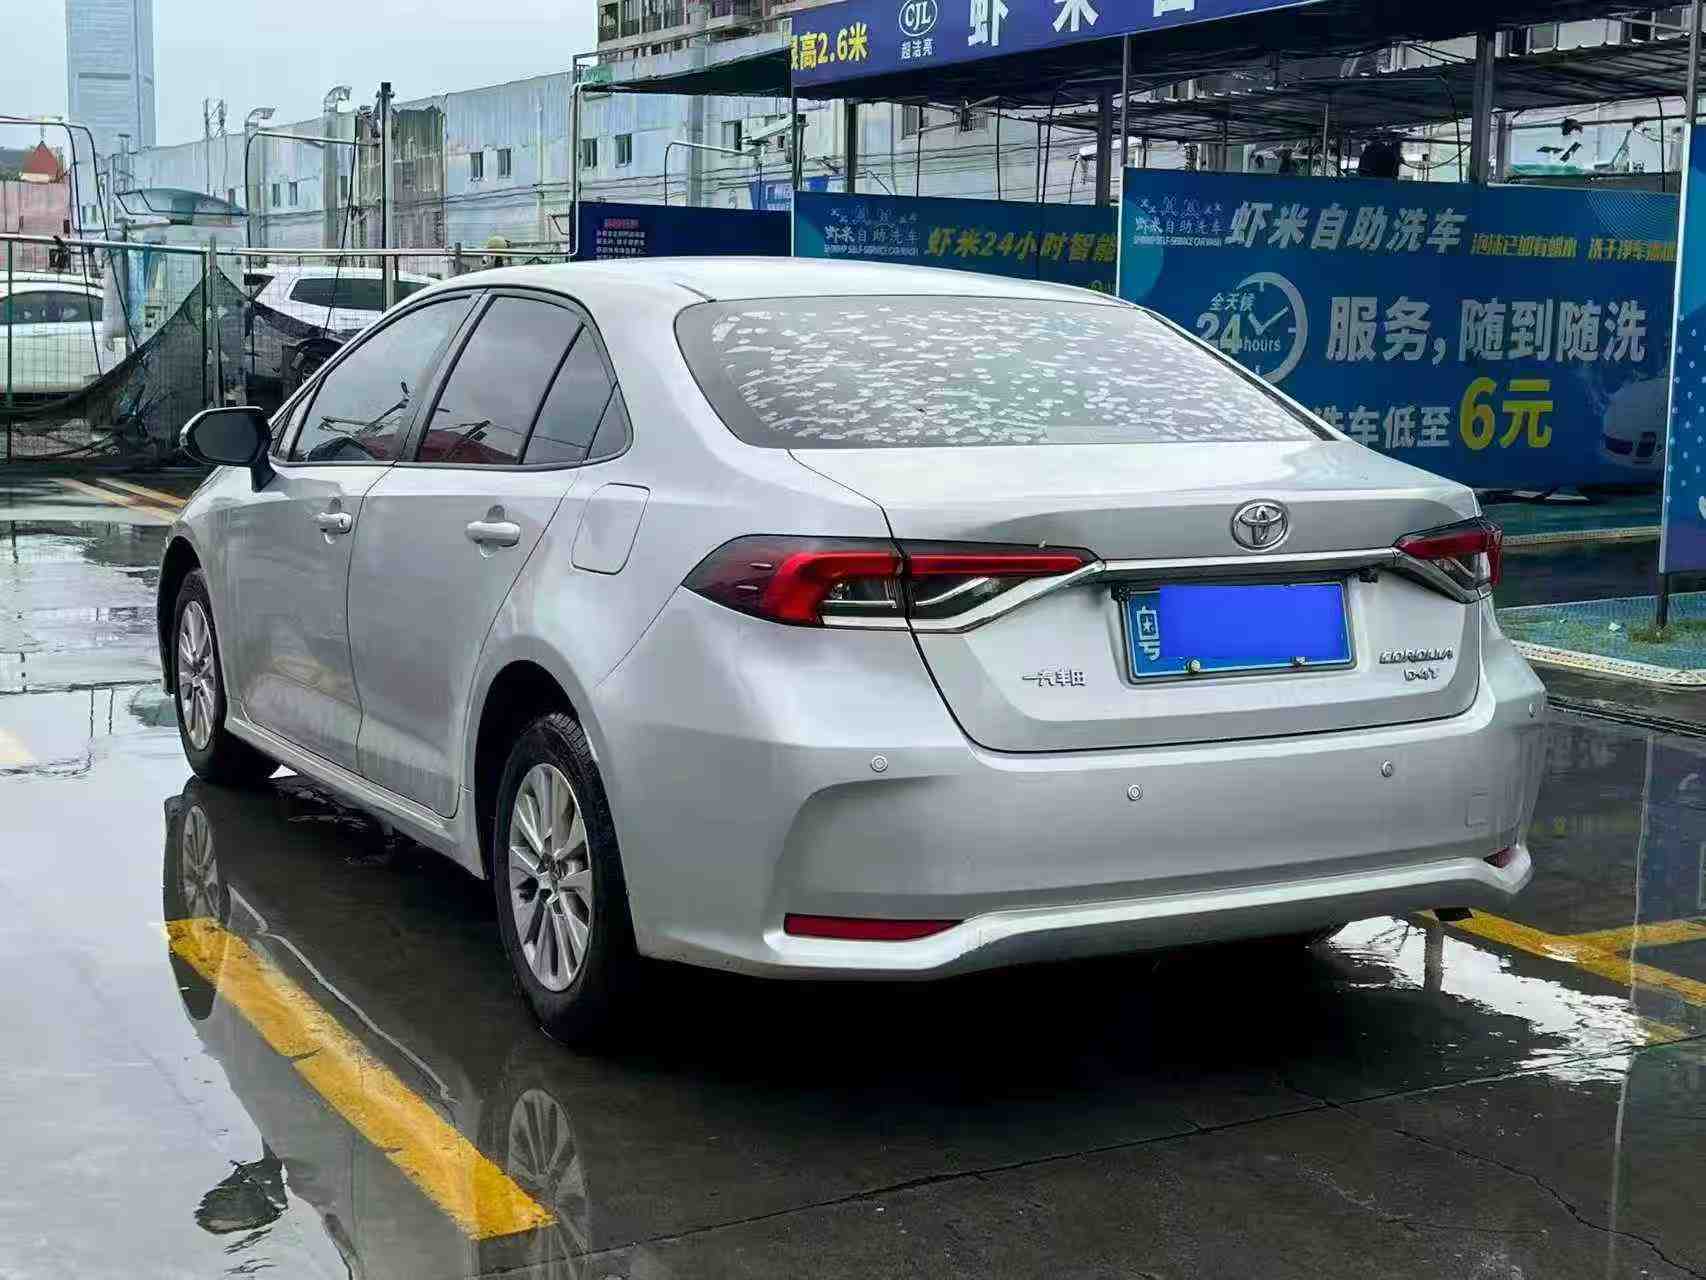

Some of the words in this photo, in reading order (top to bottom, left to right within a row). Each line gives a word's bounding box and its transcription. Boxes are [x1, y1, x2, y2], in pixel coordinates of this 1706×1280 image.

[904, 1, 931, 31] CJL
[967, 0, 1195, 46] 虾米
[924, 227, 1119, 263] 虾米24小时智能
[1223, 202, 1468, 253] 虾米自助洗车
[1208, 291, 1254, 312] 全天候
[1197, 312, 1241, 355] 24
[1243, 335, 1281, 352] hours
[1460, 376, 1554, 450] 6元
[1022, 669, 1085, 687] 一汽丰田
